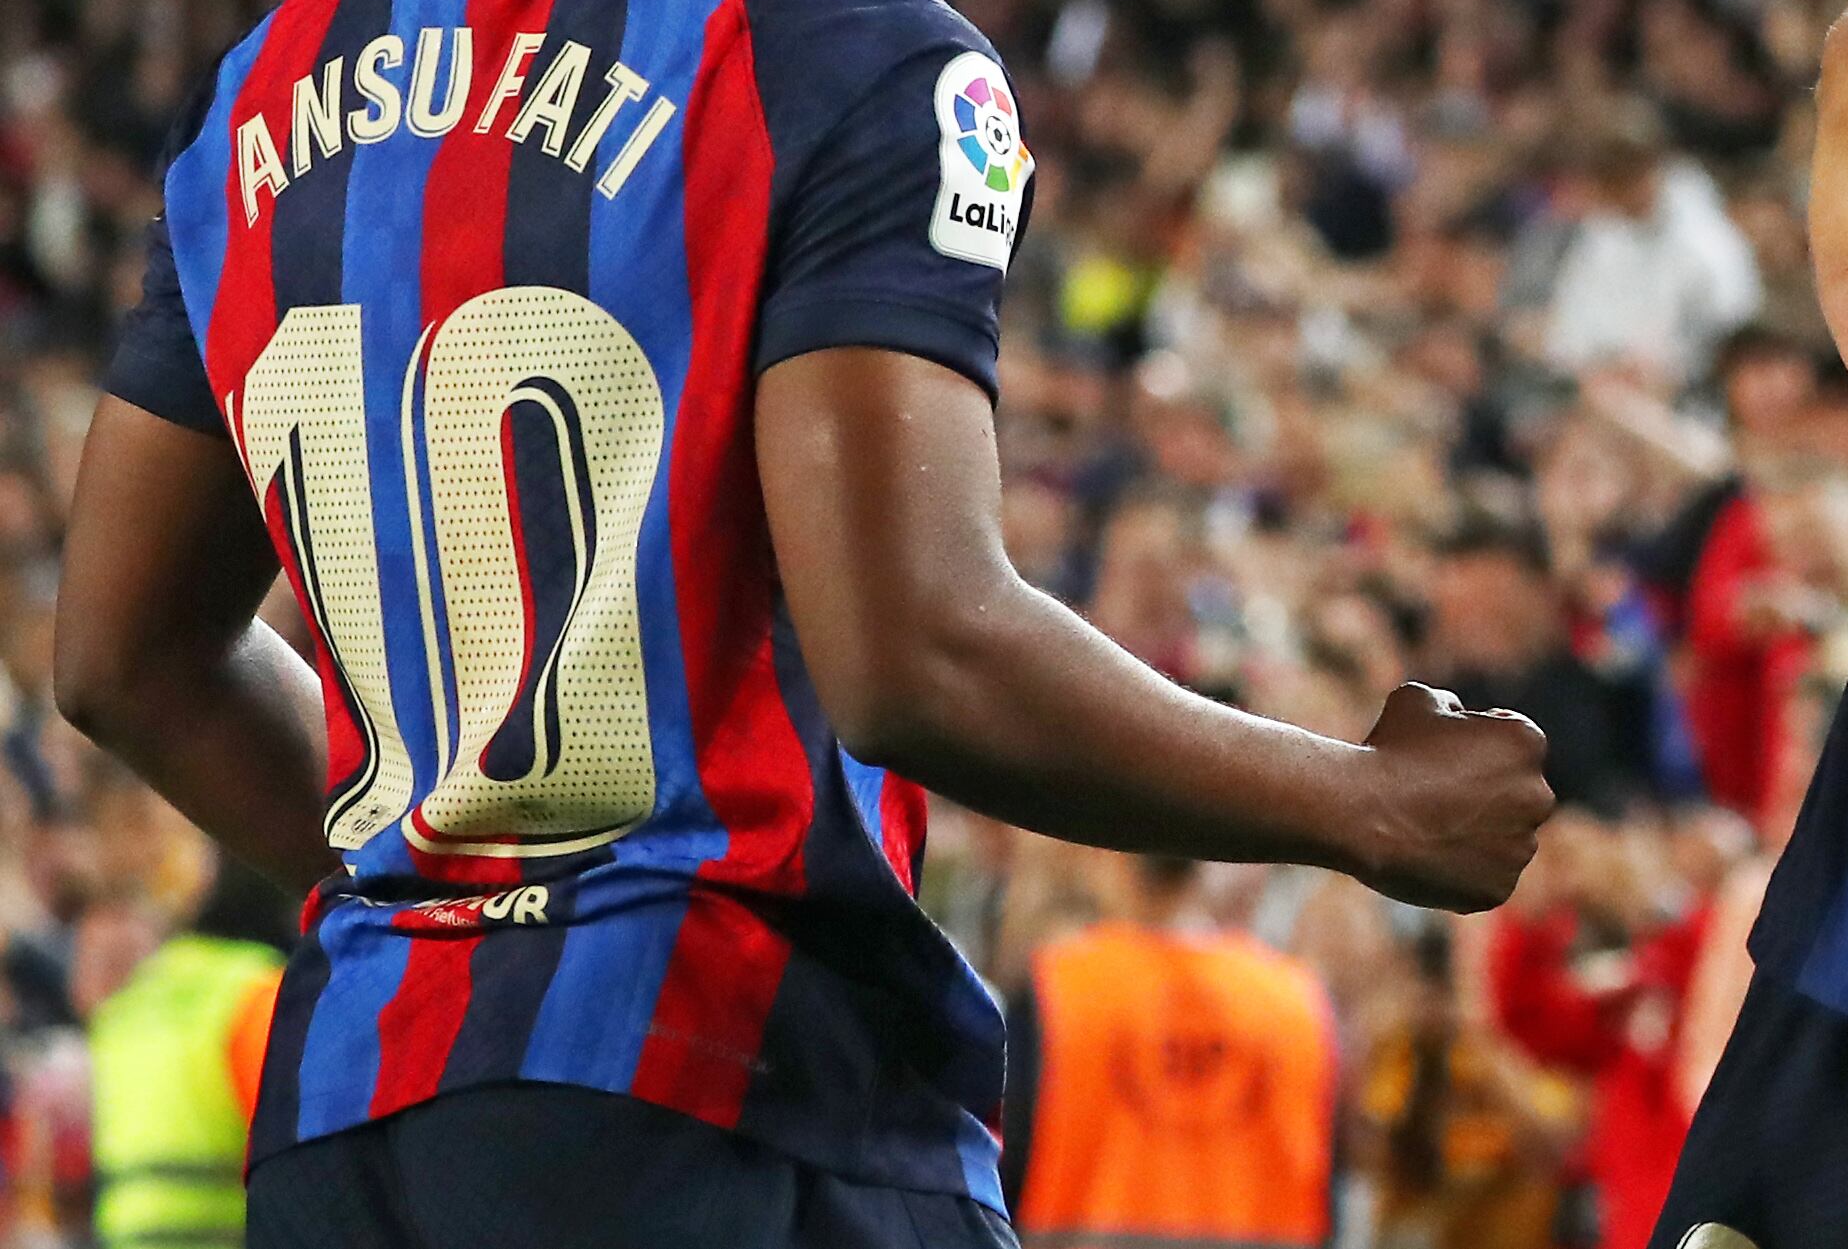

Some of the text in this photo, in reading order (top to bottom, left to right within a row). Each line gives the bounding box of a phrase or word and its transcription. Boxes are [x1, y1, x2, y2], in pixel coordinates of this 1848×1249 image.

[236, 26, 677, 228] ANSU FATI
[224, 285, 664, 859] 10
